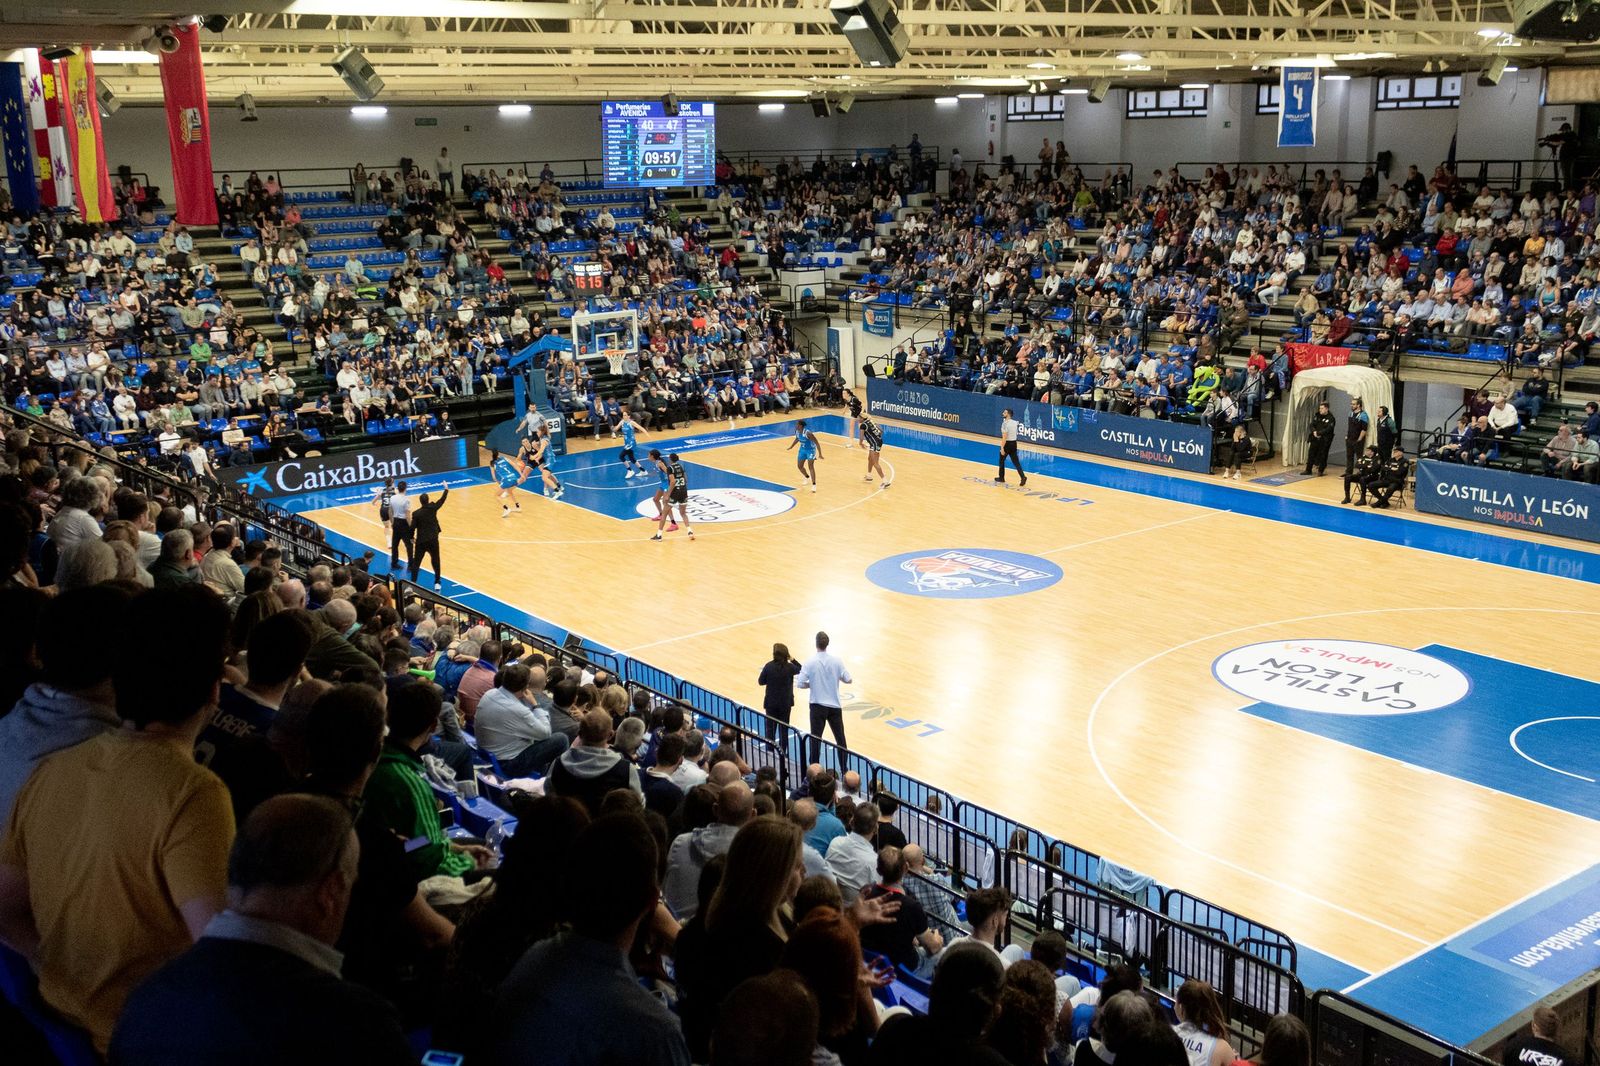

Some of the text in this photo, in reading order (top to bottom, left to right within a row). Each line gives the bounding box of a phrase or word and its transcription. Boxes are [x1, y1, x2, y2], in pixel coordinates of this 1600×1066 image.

[1293, 84, 1304, 110] 4
[641, 120, 654, 130] 40
[666, 120, 679, 130] 47
[645, 151, 677, 165] 09:51
[647, 169, 652, 177] 0
[671, 168, 677, 177] 0
[588, 275, 603, 288] 15
[871, 400, 960, 423] perfumeriasavenida.com
[1100, 429, 1204, 457] CASTILLA Y LEÓN
[1126, 448, 1174, 464] NOS IMPULSA
[275, 447, 422, 493] CaixaBank
[674, 477, 686, 487] 23
[1436, 482, 1589, 520] CASTILLA Y LEÓN
[1473, 506, 1544, 528] NOS IMPULSA
[938, 552, 1045, 581] AVENIDA
[1284, 643, 1441, 680] NOS IMPULSA
[1259, 657, 1404, 694] Y LEÓN
[1232, 664, 1417, 710] CASTILLA
[884, 717, 945, 738] LF
